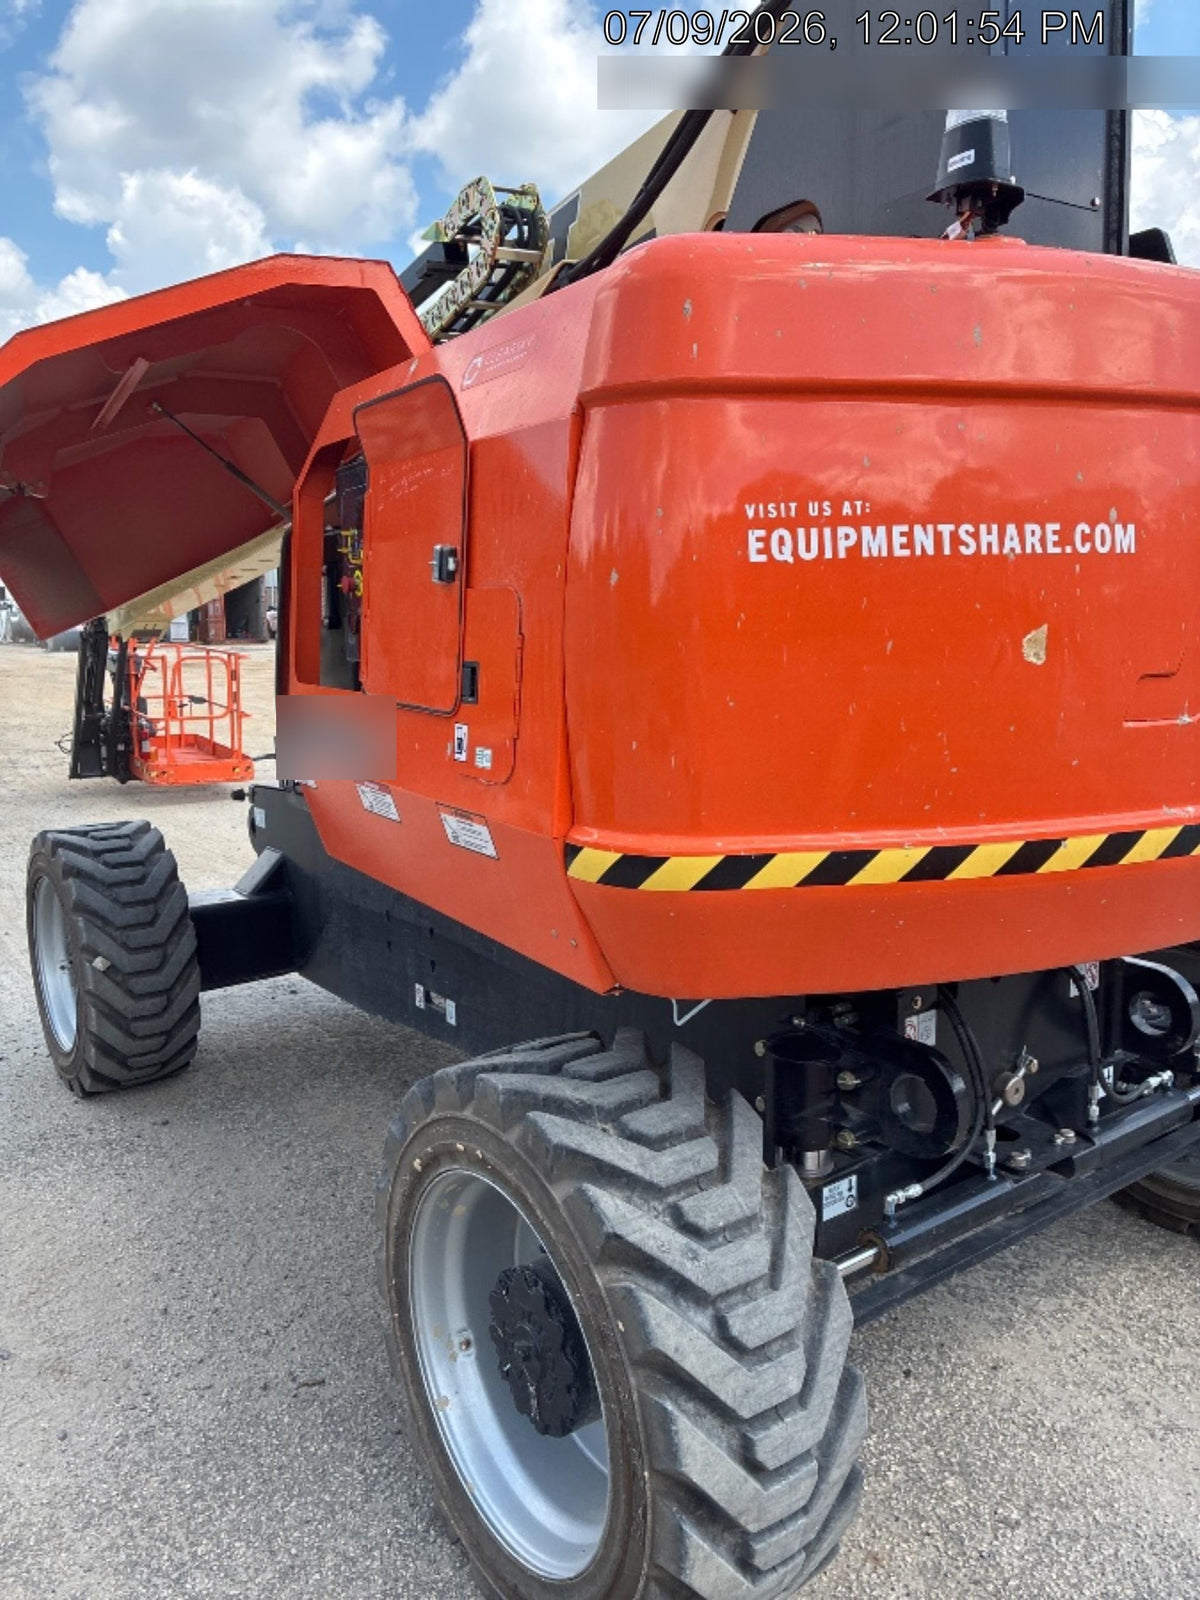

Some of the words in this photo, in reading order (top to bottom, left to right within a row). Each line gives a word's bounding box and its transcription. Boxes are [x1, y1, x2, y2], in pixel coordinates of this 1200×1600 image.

[745, 502, 797, 518] VISIT
[808, 501, 832, 516] US
[842, 500, 870, 515] AT:
[747, 523, 1137, 562] EQUIPMENTSHARE.COM
